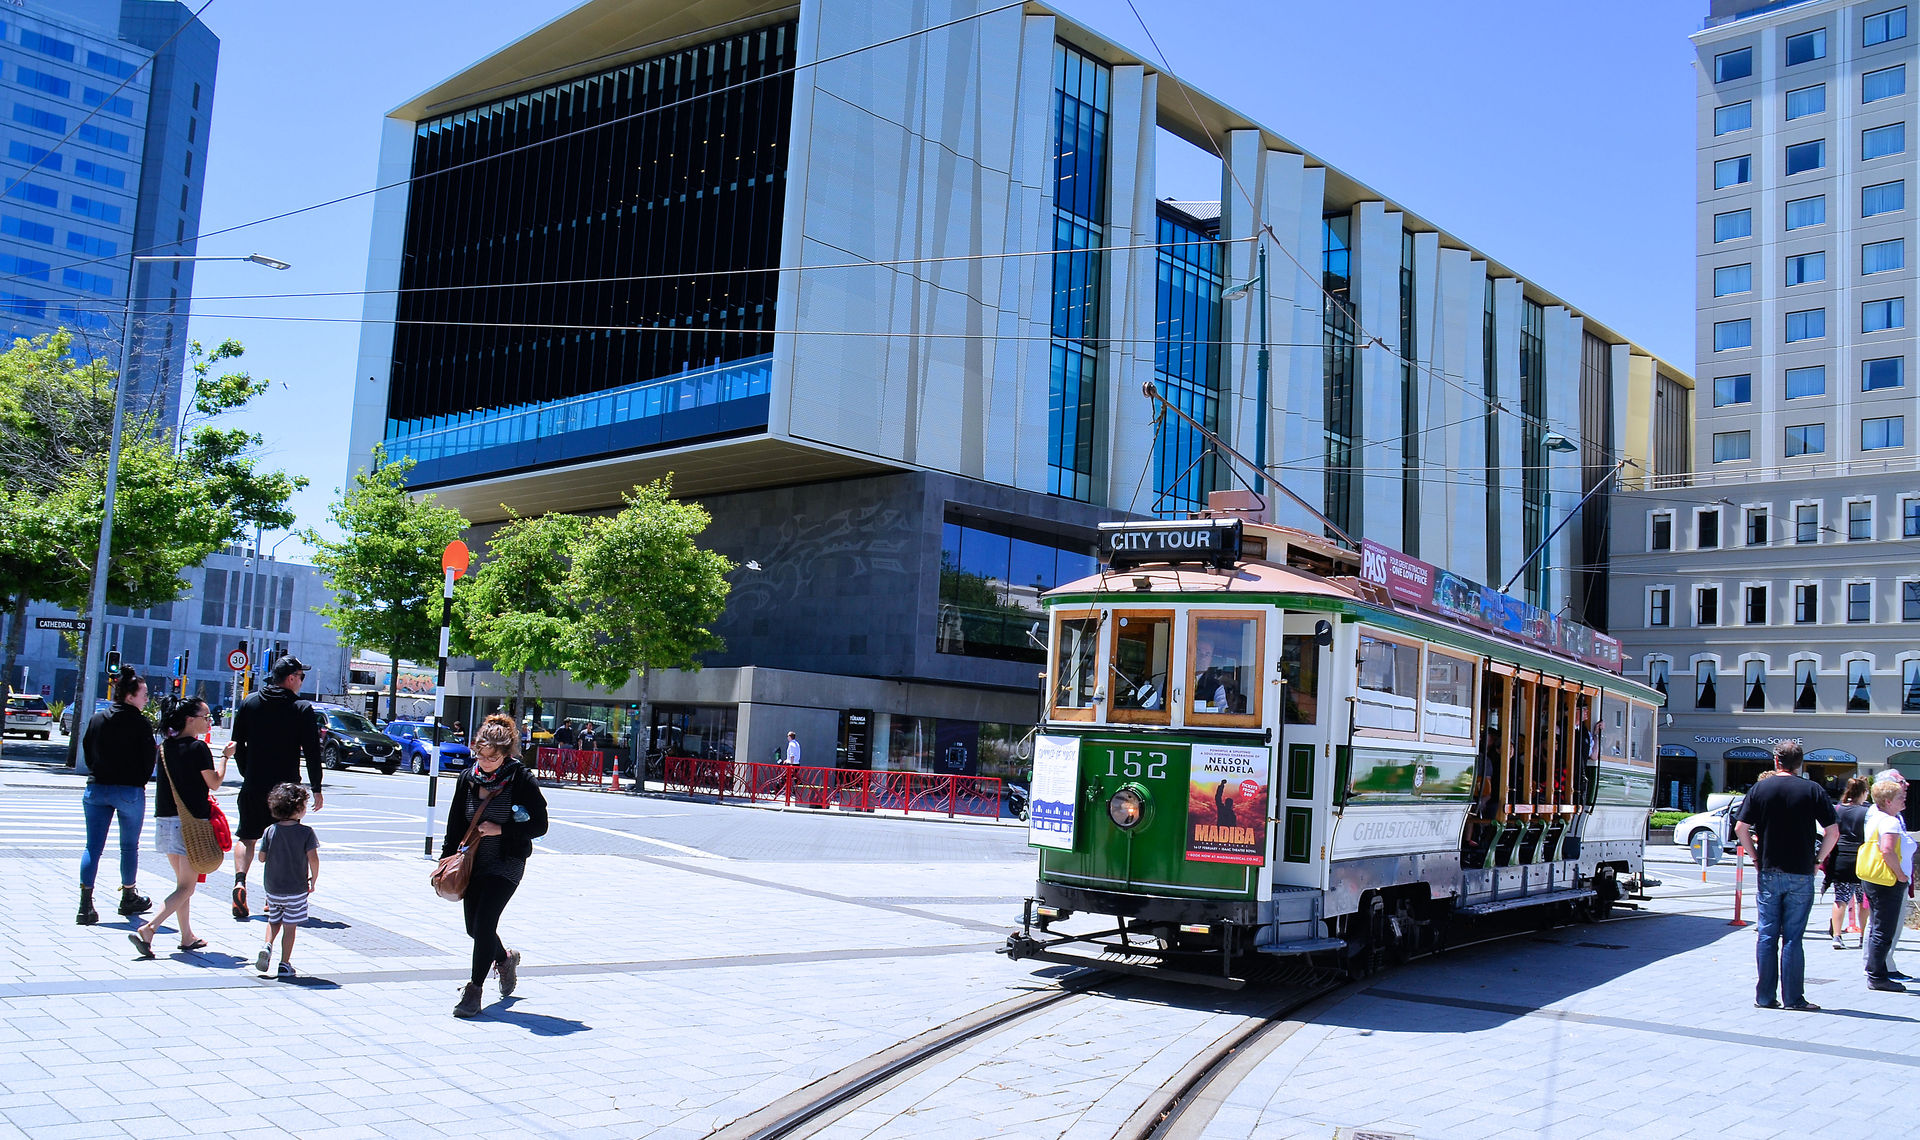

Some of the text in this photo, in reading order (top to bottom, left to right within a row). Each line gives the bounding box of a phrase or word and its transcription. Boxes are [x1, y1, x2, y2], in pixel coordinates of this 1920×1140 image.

[1111, 531, 1211, 550] CITY TOUR
[1363, 549, 1387, 584] PASS
[1392, 566, 1427, 585] ONE LOW PRICE
[39, 620, 74, 629] CATHEDRAL
[232, 656, 244, 664] 30
[1695, 735, 1741, 744] SOUVENIRS
[1209, 757, 1250, 765] NELSON
[1729, 750, 1769, 758] SOUVENIRS
[1105, 749, 1168, 779] 152
[1204, 765, 1254, 773] MANDELA
[1194, 824, 1255, 845] MADIBA
[1354, 820, 1451, 840] CHRISTCHURCH
